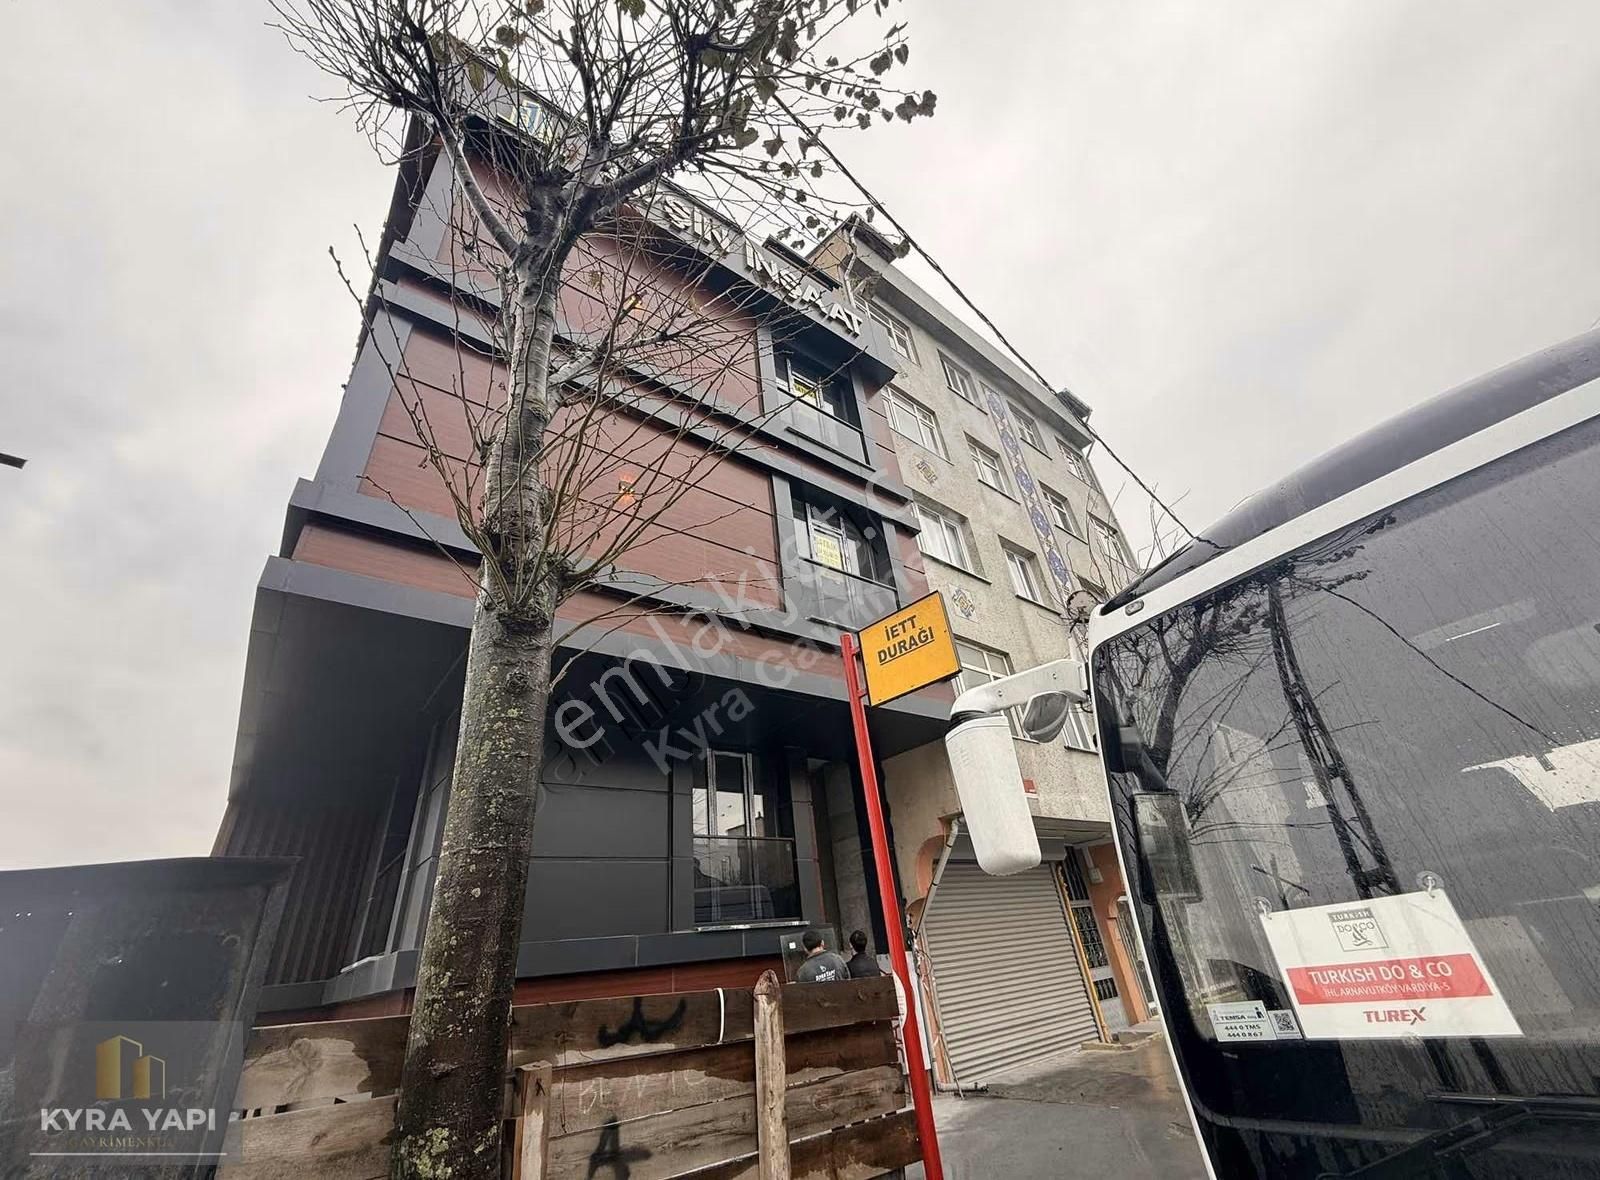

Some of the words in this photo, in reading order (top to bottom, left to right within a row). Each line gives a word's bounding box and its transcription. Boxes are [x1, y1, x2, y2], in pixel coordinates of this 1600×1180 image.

[885, 614, 917, 641] İETT
[877, 625, 935, 662] DURAĞI
[1308, 967, 1378, 985] TURKISH
[1379, 965, 1406, 981] DO
[1408, 964, 1425, 979] &
[1426, 961, 1453, 977] CO
[1363, 1006, 1427, 1026] TUREX
